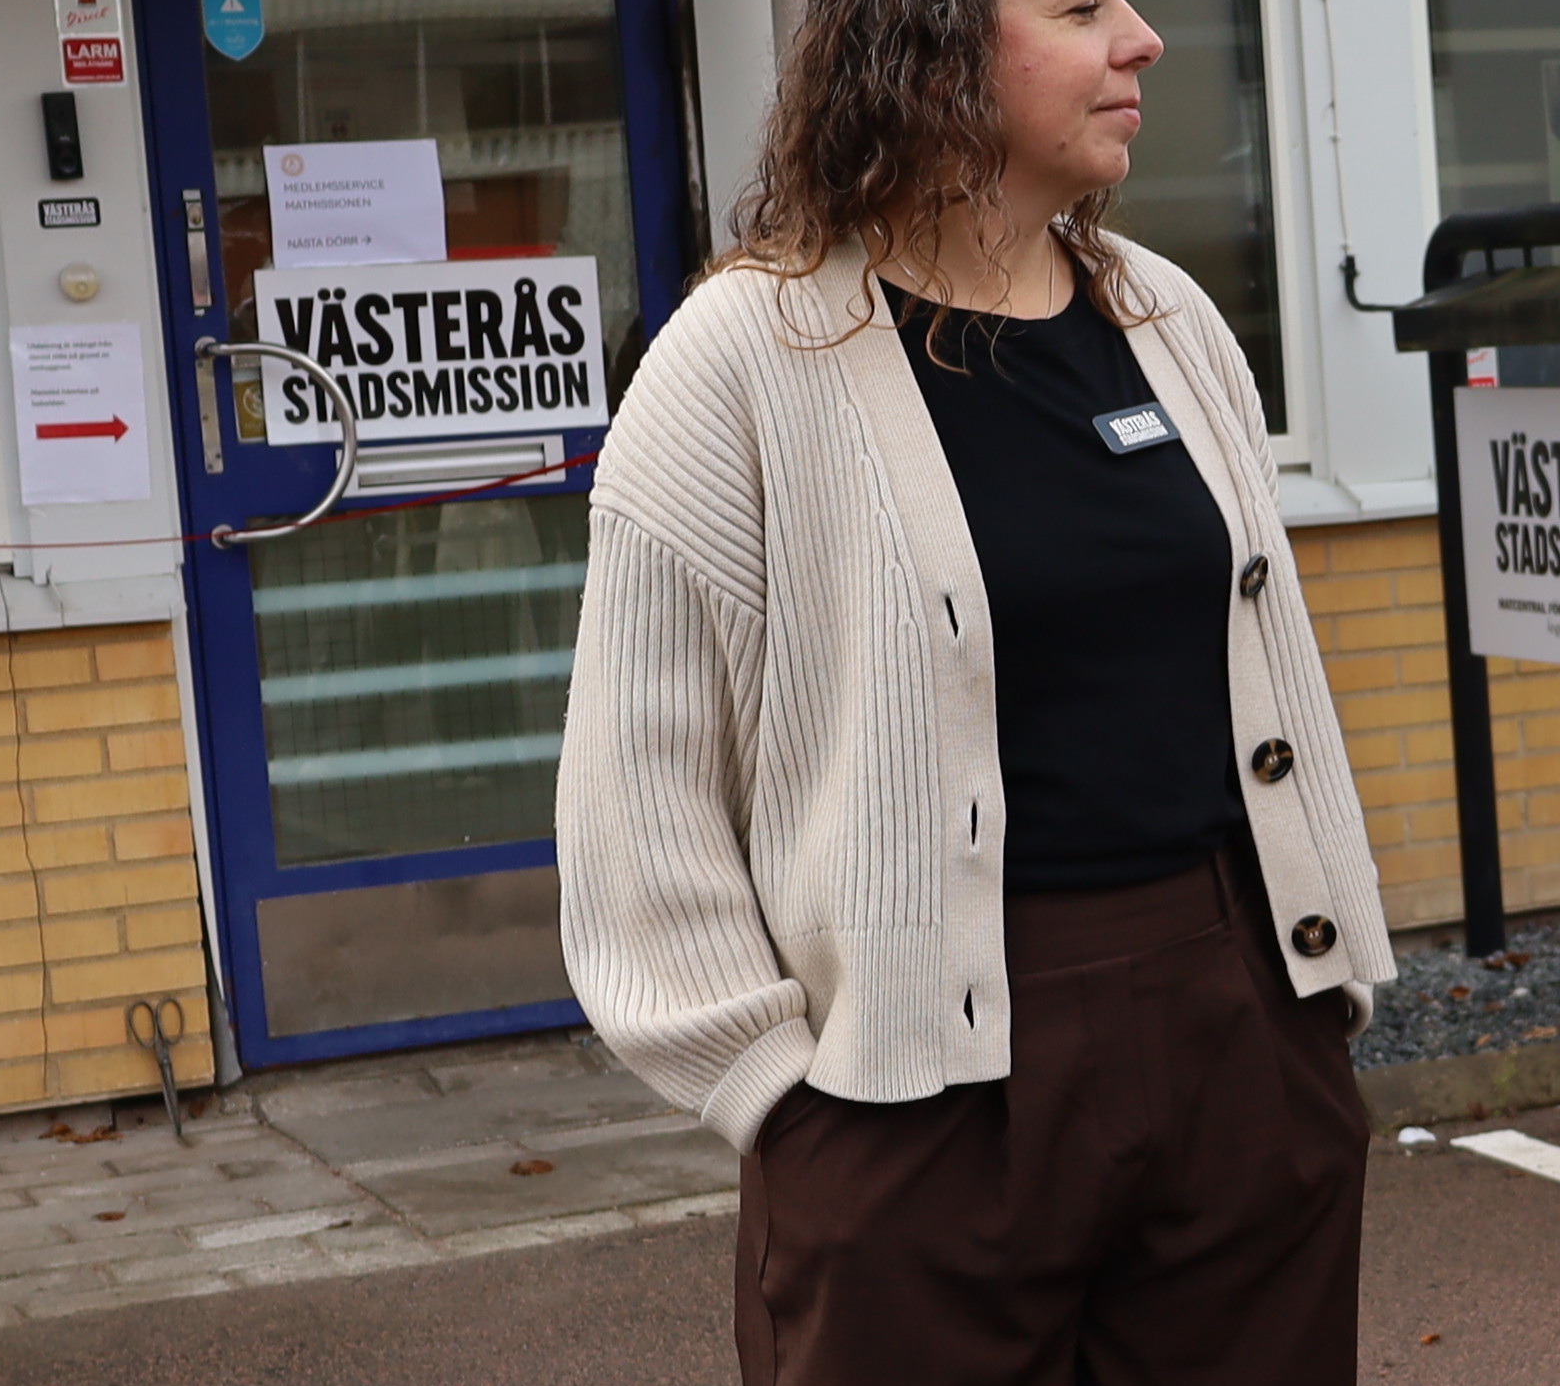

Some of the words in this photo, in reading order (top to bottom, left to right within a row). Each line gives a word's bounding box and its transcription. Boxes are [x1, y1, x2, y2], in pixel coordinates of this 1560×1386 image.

[66, 42, 119, 60] LARM
[283, 178, 386, 193] MEDLEMSSERVICE
[285, 197, 372, 211] MATMISSIONEN
[287, 236, 324, 250] NÄSTA
[325, 234, 359, 248] DÖRR
[274, 276, 586, 369] VÄSTERÅS
[282, 361, 590, 425] STADSMISSION
